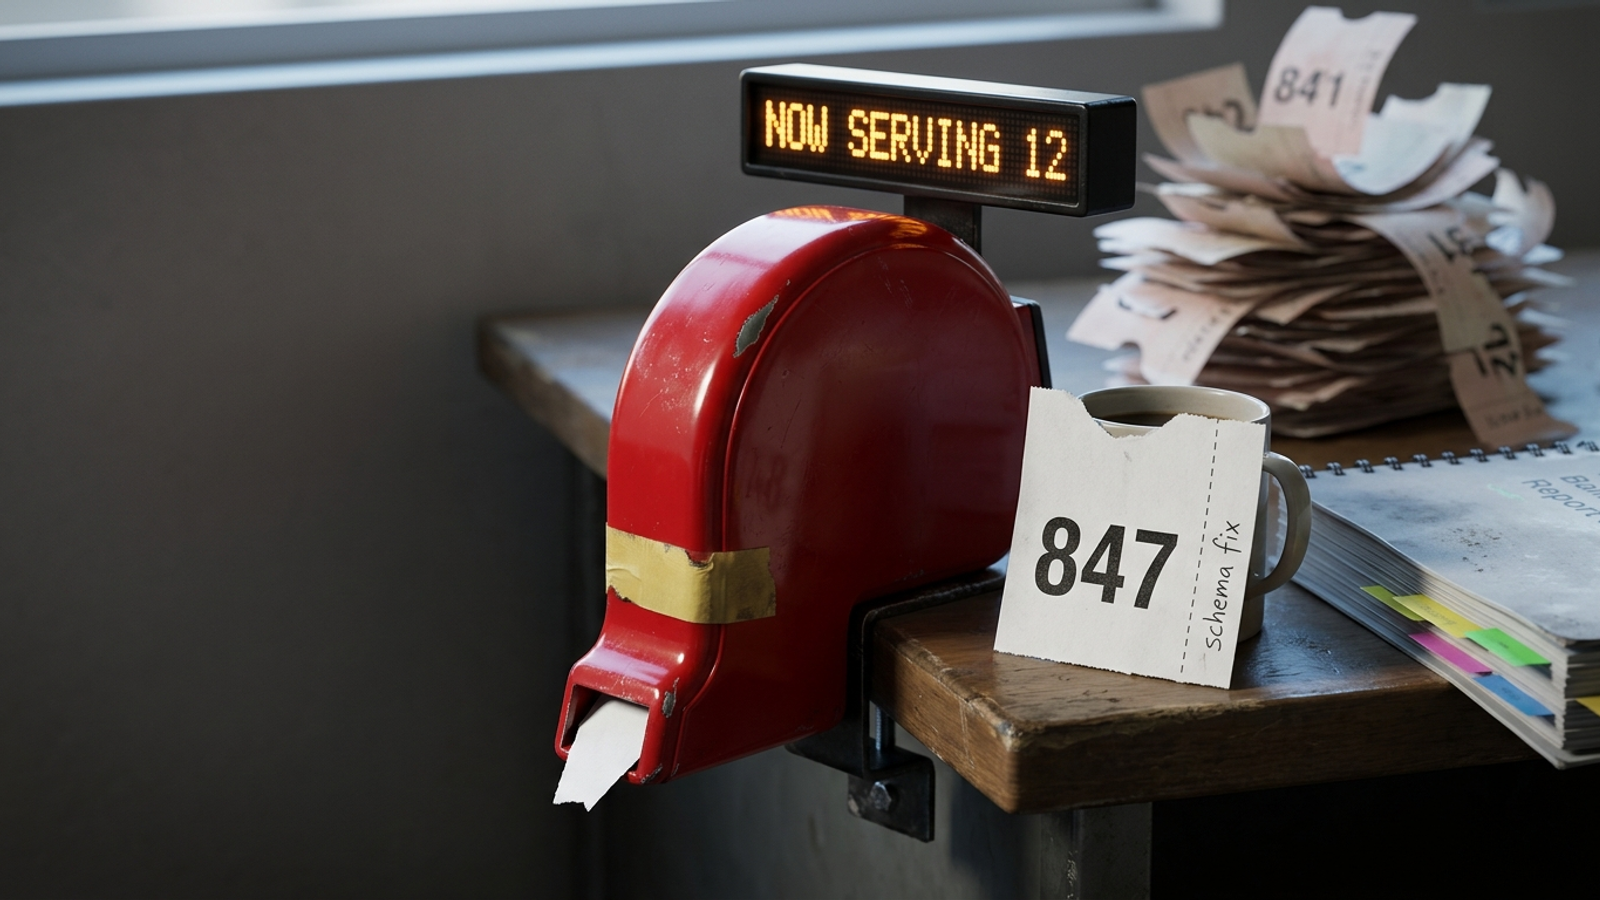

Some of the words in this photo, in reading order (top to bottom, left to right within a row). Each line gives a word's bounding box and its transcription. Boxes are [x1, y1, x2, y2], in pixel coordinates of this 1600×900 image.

[1274, 65, 1345, 108] 841
[765, 99, 829, 154] NOW
[847, 109, 1001, 174] SERVING
[1025, 127, 1068, 182] 12
[1034, 516, 1179, 610] 847
[1211, 520, 1242, 555] fix
[1202, 565, 1234, 652] schema
